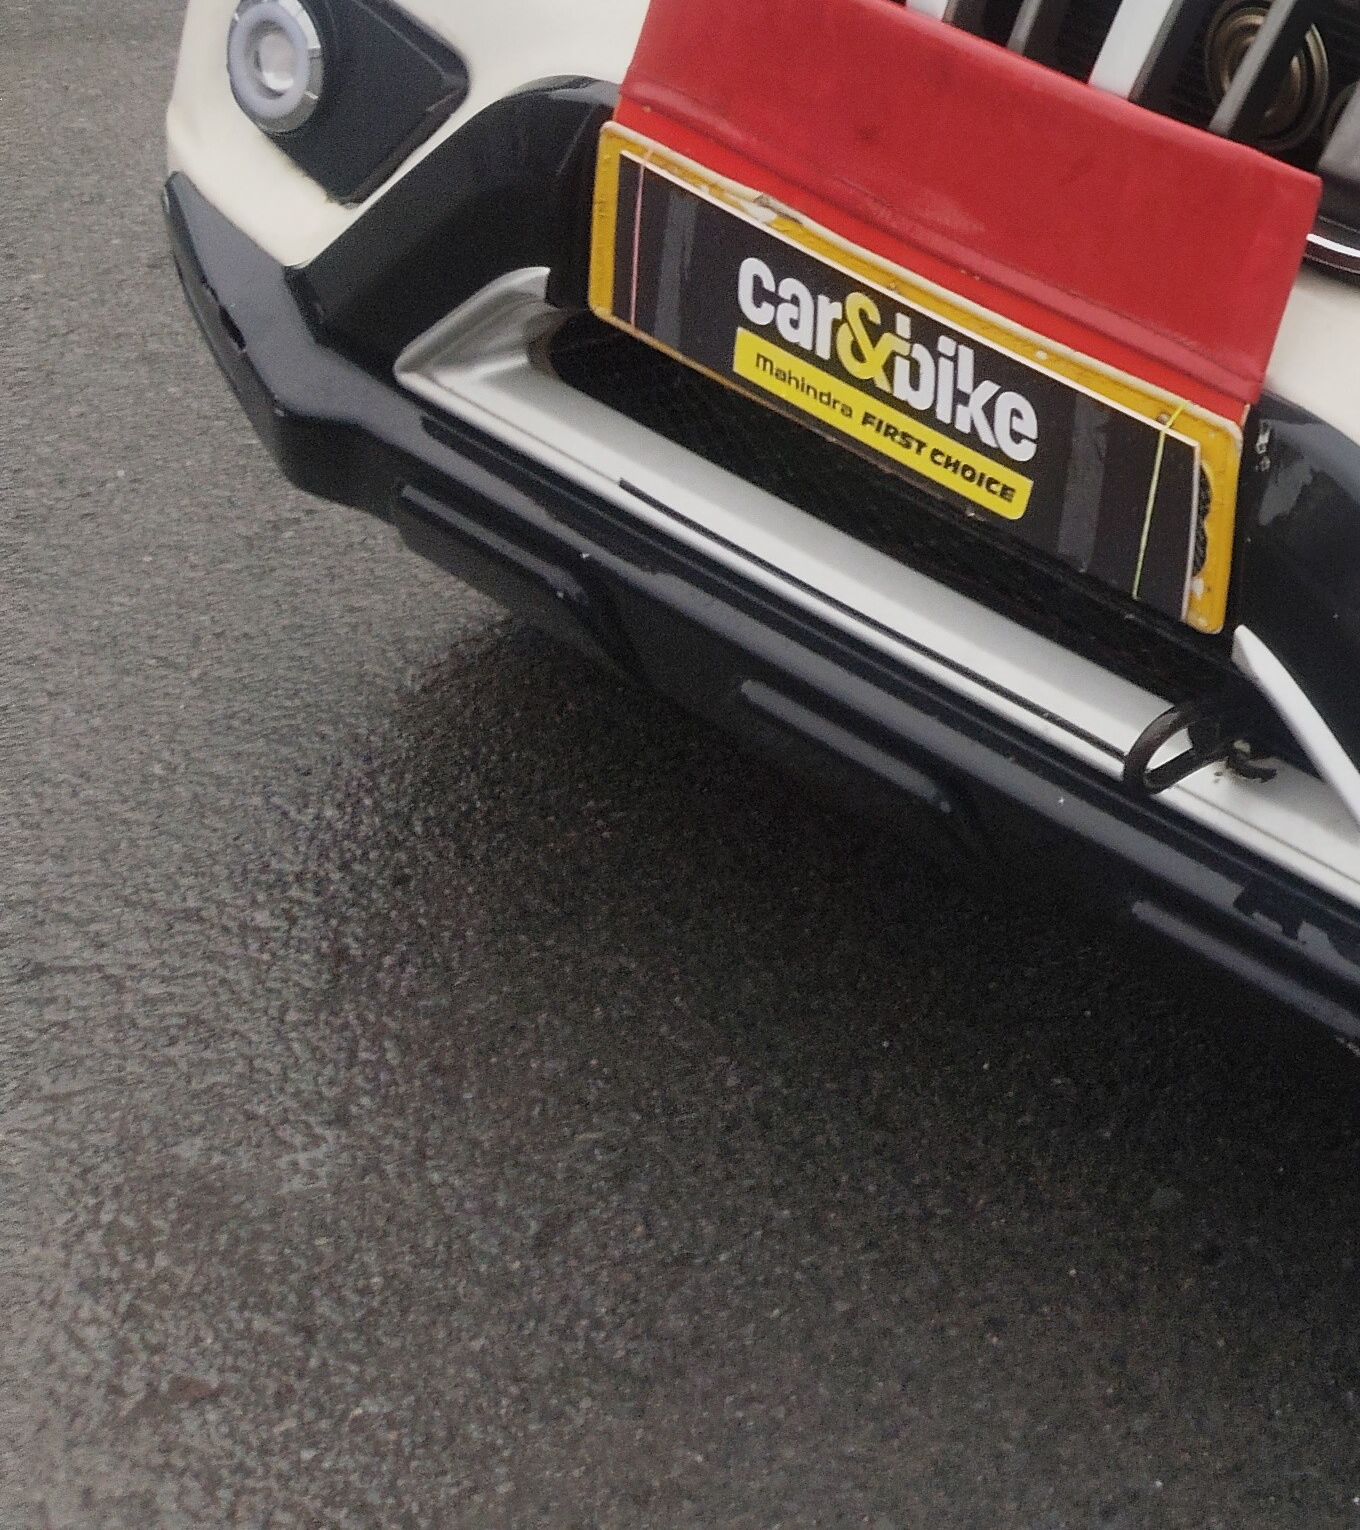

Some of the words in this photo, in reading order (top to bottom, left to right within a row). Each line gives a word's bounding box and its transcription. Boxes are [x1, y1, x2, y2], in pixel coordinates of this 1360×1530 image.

[737, 256, 1039, 463] car&bike
[861, 410, 929, 456] FIRST
[929, 447, 1017, 504] CHOICE
